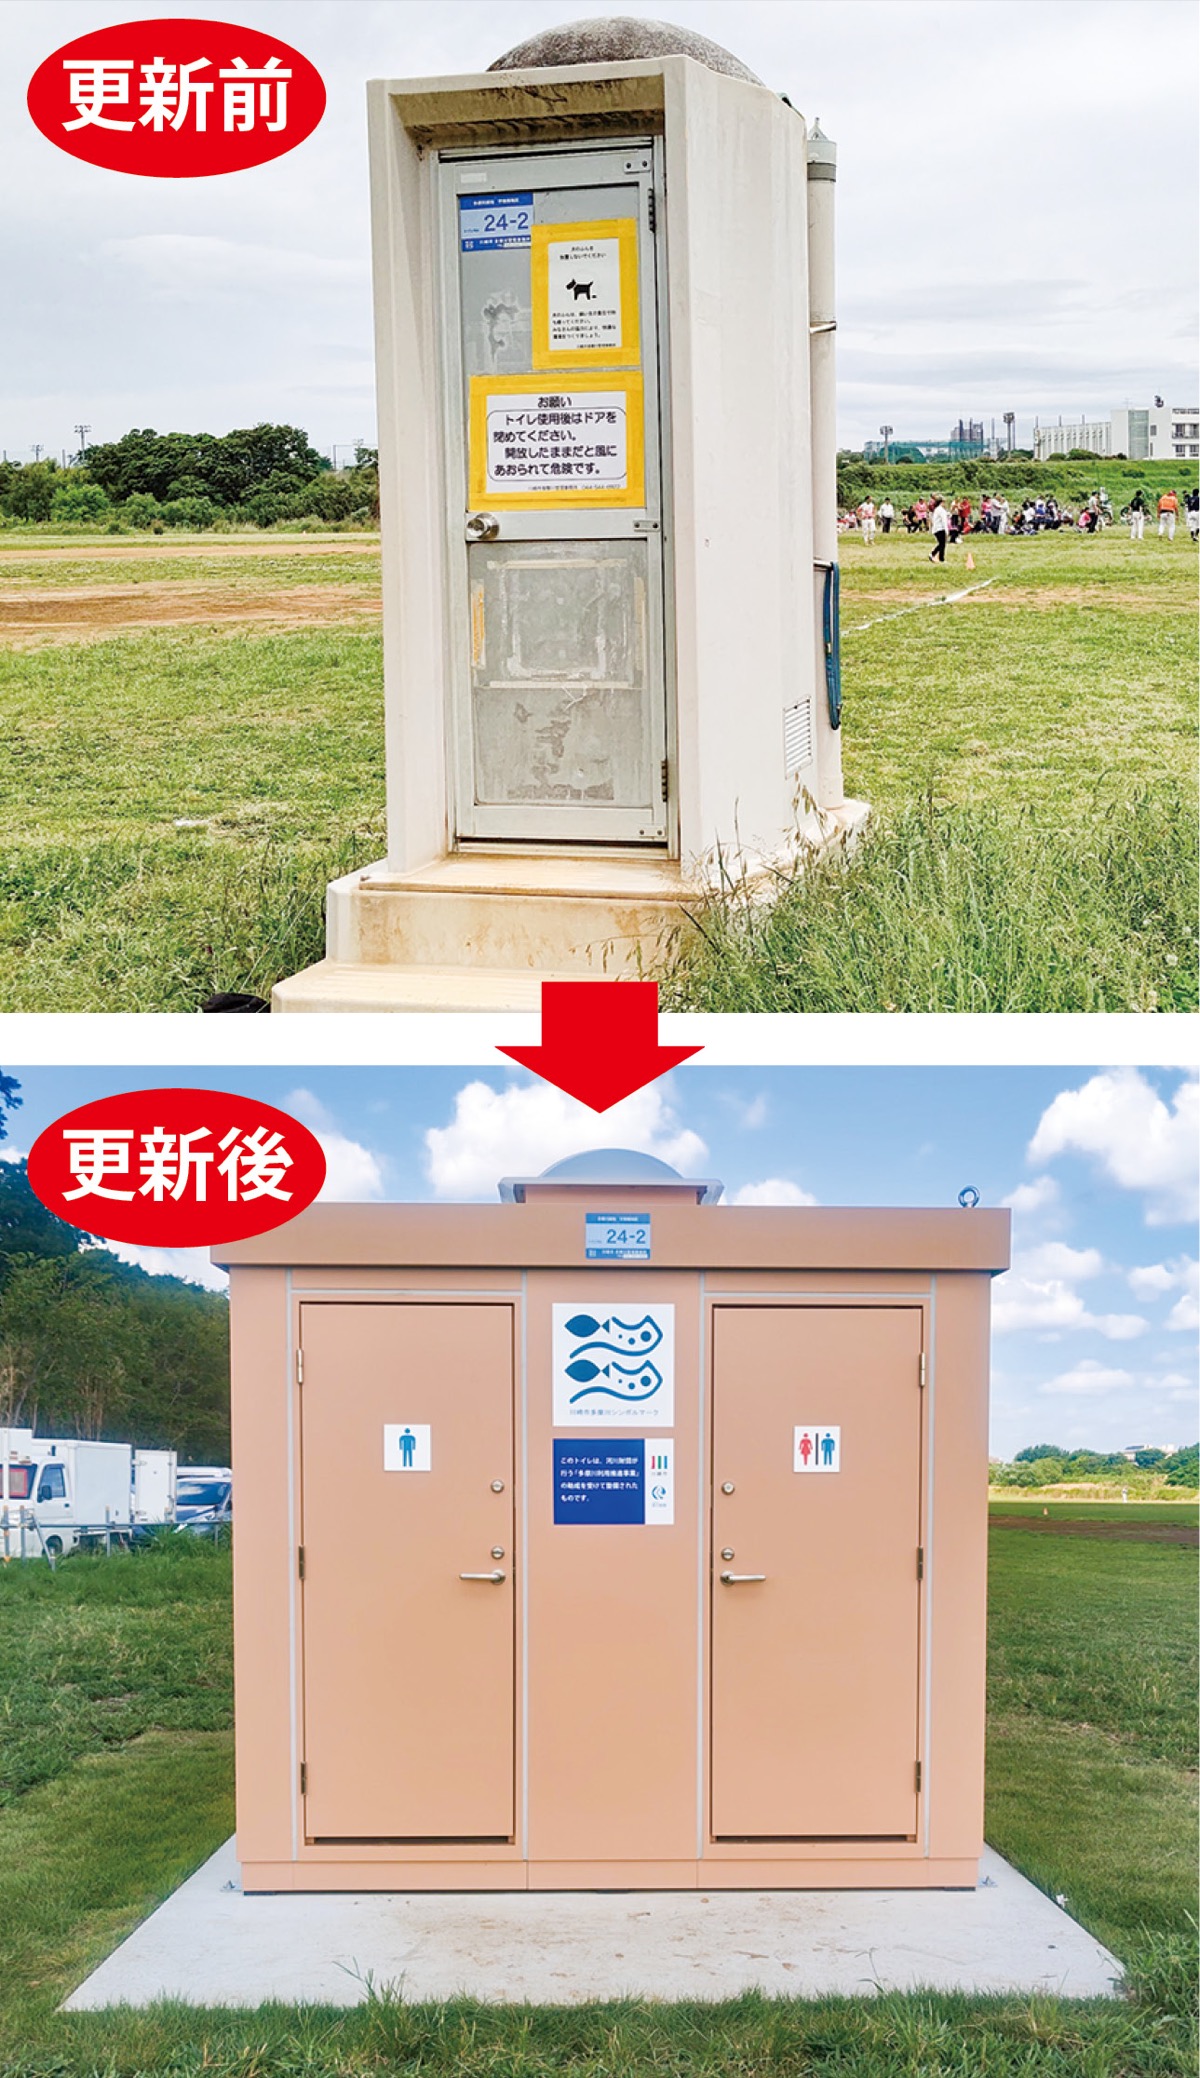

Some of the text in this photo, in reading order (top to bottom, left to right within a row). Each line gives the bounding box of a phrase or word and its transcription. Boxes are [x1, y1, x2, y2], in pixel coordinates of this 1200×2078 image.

[483, 212, 529, 232] 24-2
[537, 396, 573, 408] お願い
[504, 411, 617, 426] トイレ使用後はドアを
[493, 430, 577, 443] 閉めてください。
[504, 445, 617, 459] 開放したままだと風に
[494, 463, 600, 476] あおられて危険です。
[606, 1228, 646, 1244] 24-2
[560, 1456, 639, 1465] このトイレは、河川財団が
